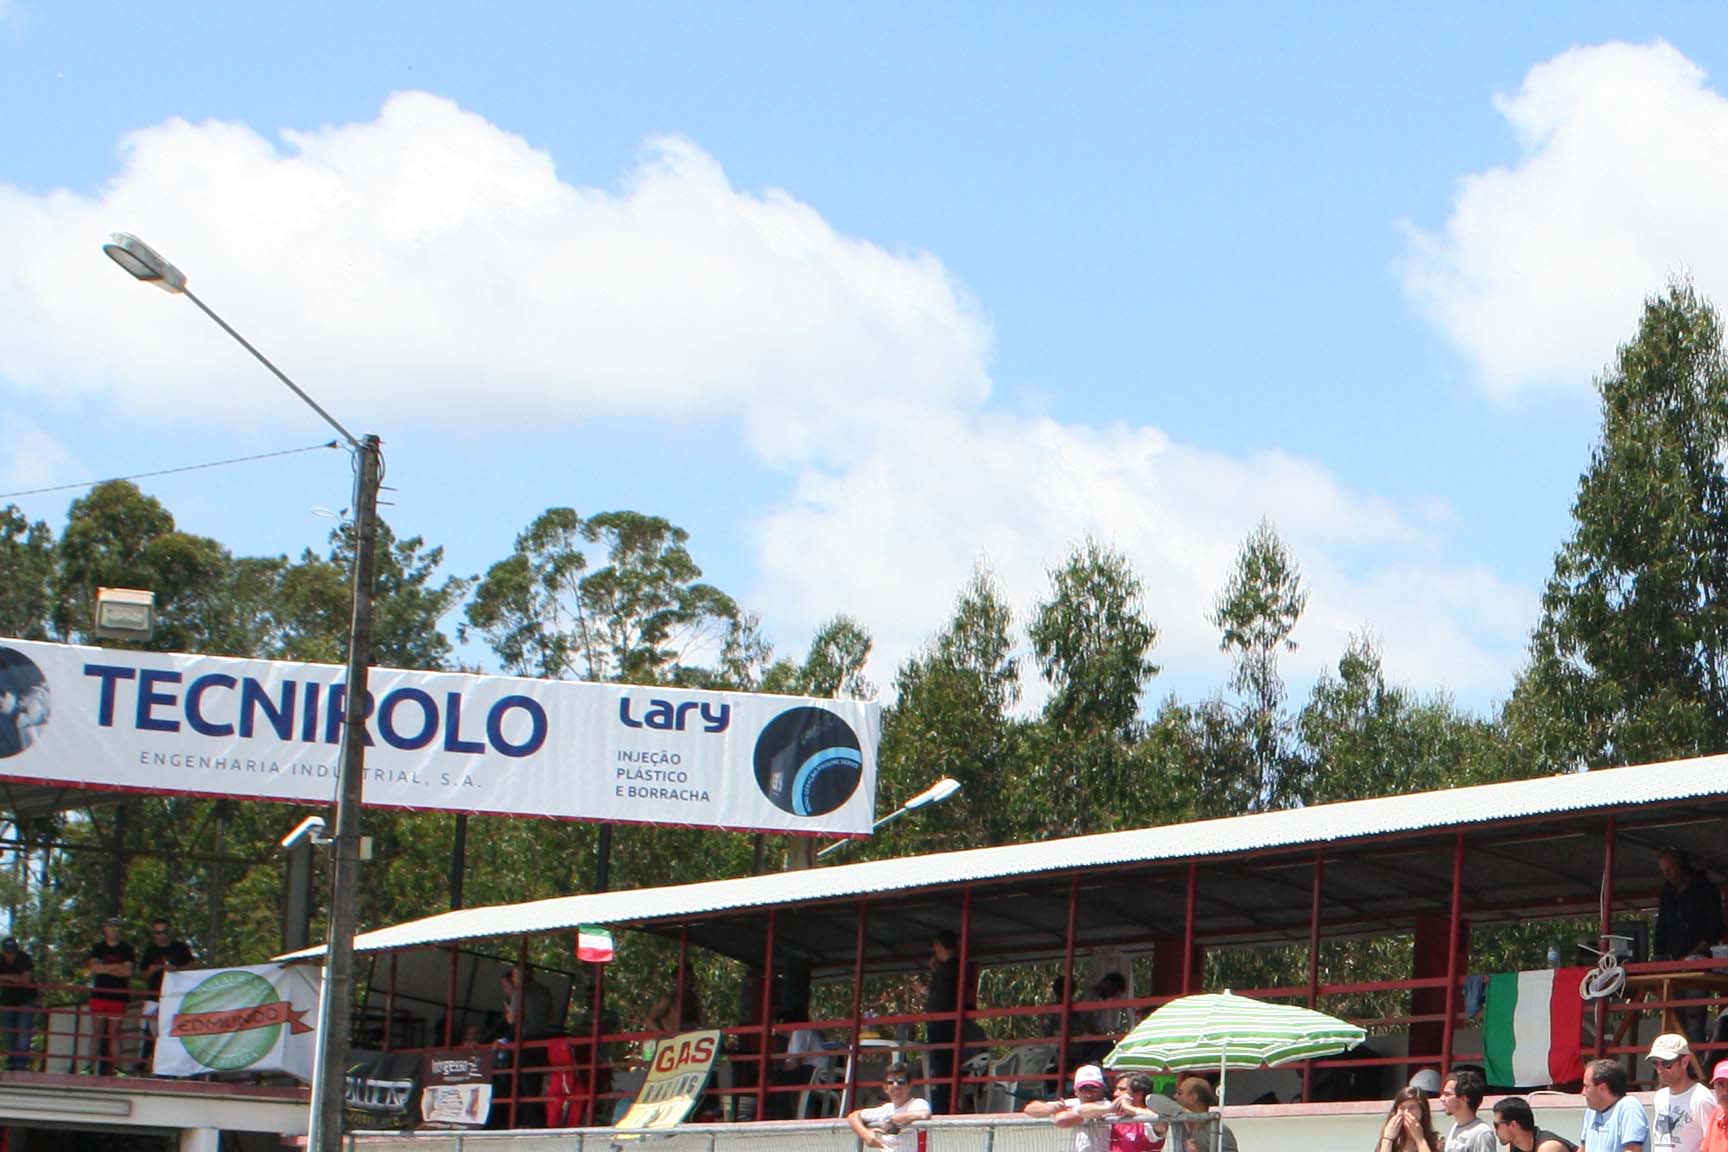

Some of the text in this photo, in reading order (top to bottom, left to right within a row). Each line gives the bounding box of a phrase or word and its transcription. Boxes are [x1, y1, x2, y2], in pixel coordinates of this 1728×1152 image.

[84, 664, 548, 757] TECNIROLO
[140, 751, 482, 789] ENGENHARIA INDUTRIAL, S.A.
[617, 750, 681, 767] INJEÇÃO
[617, 766, 688, 784] PLÁSTICO
[616, 785, 710, 802] E BORRACHA
[177, 1008, 279, 1032] EDMUNDO
[656, 1037, 715, 1072] GAS
